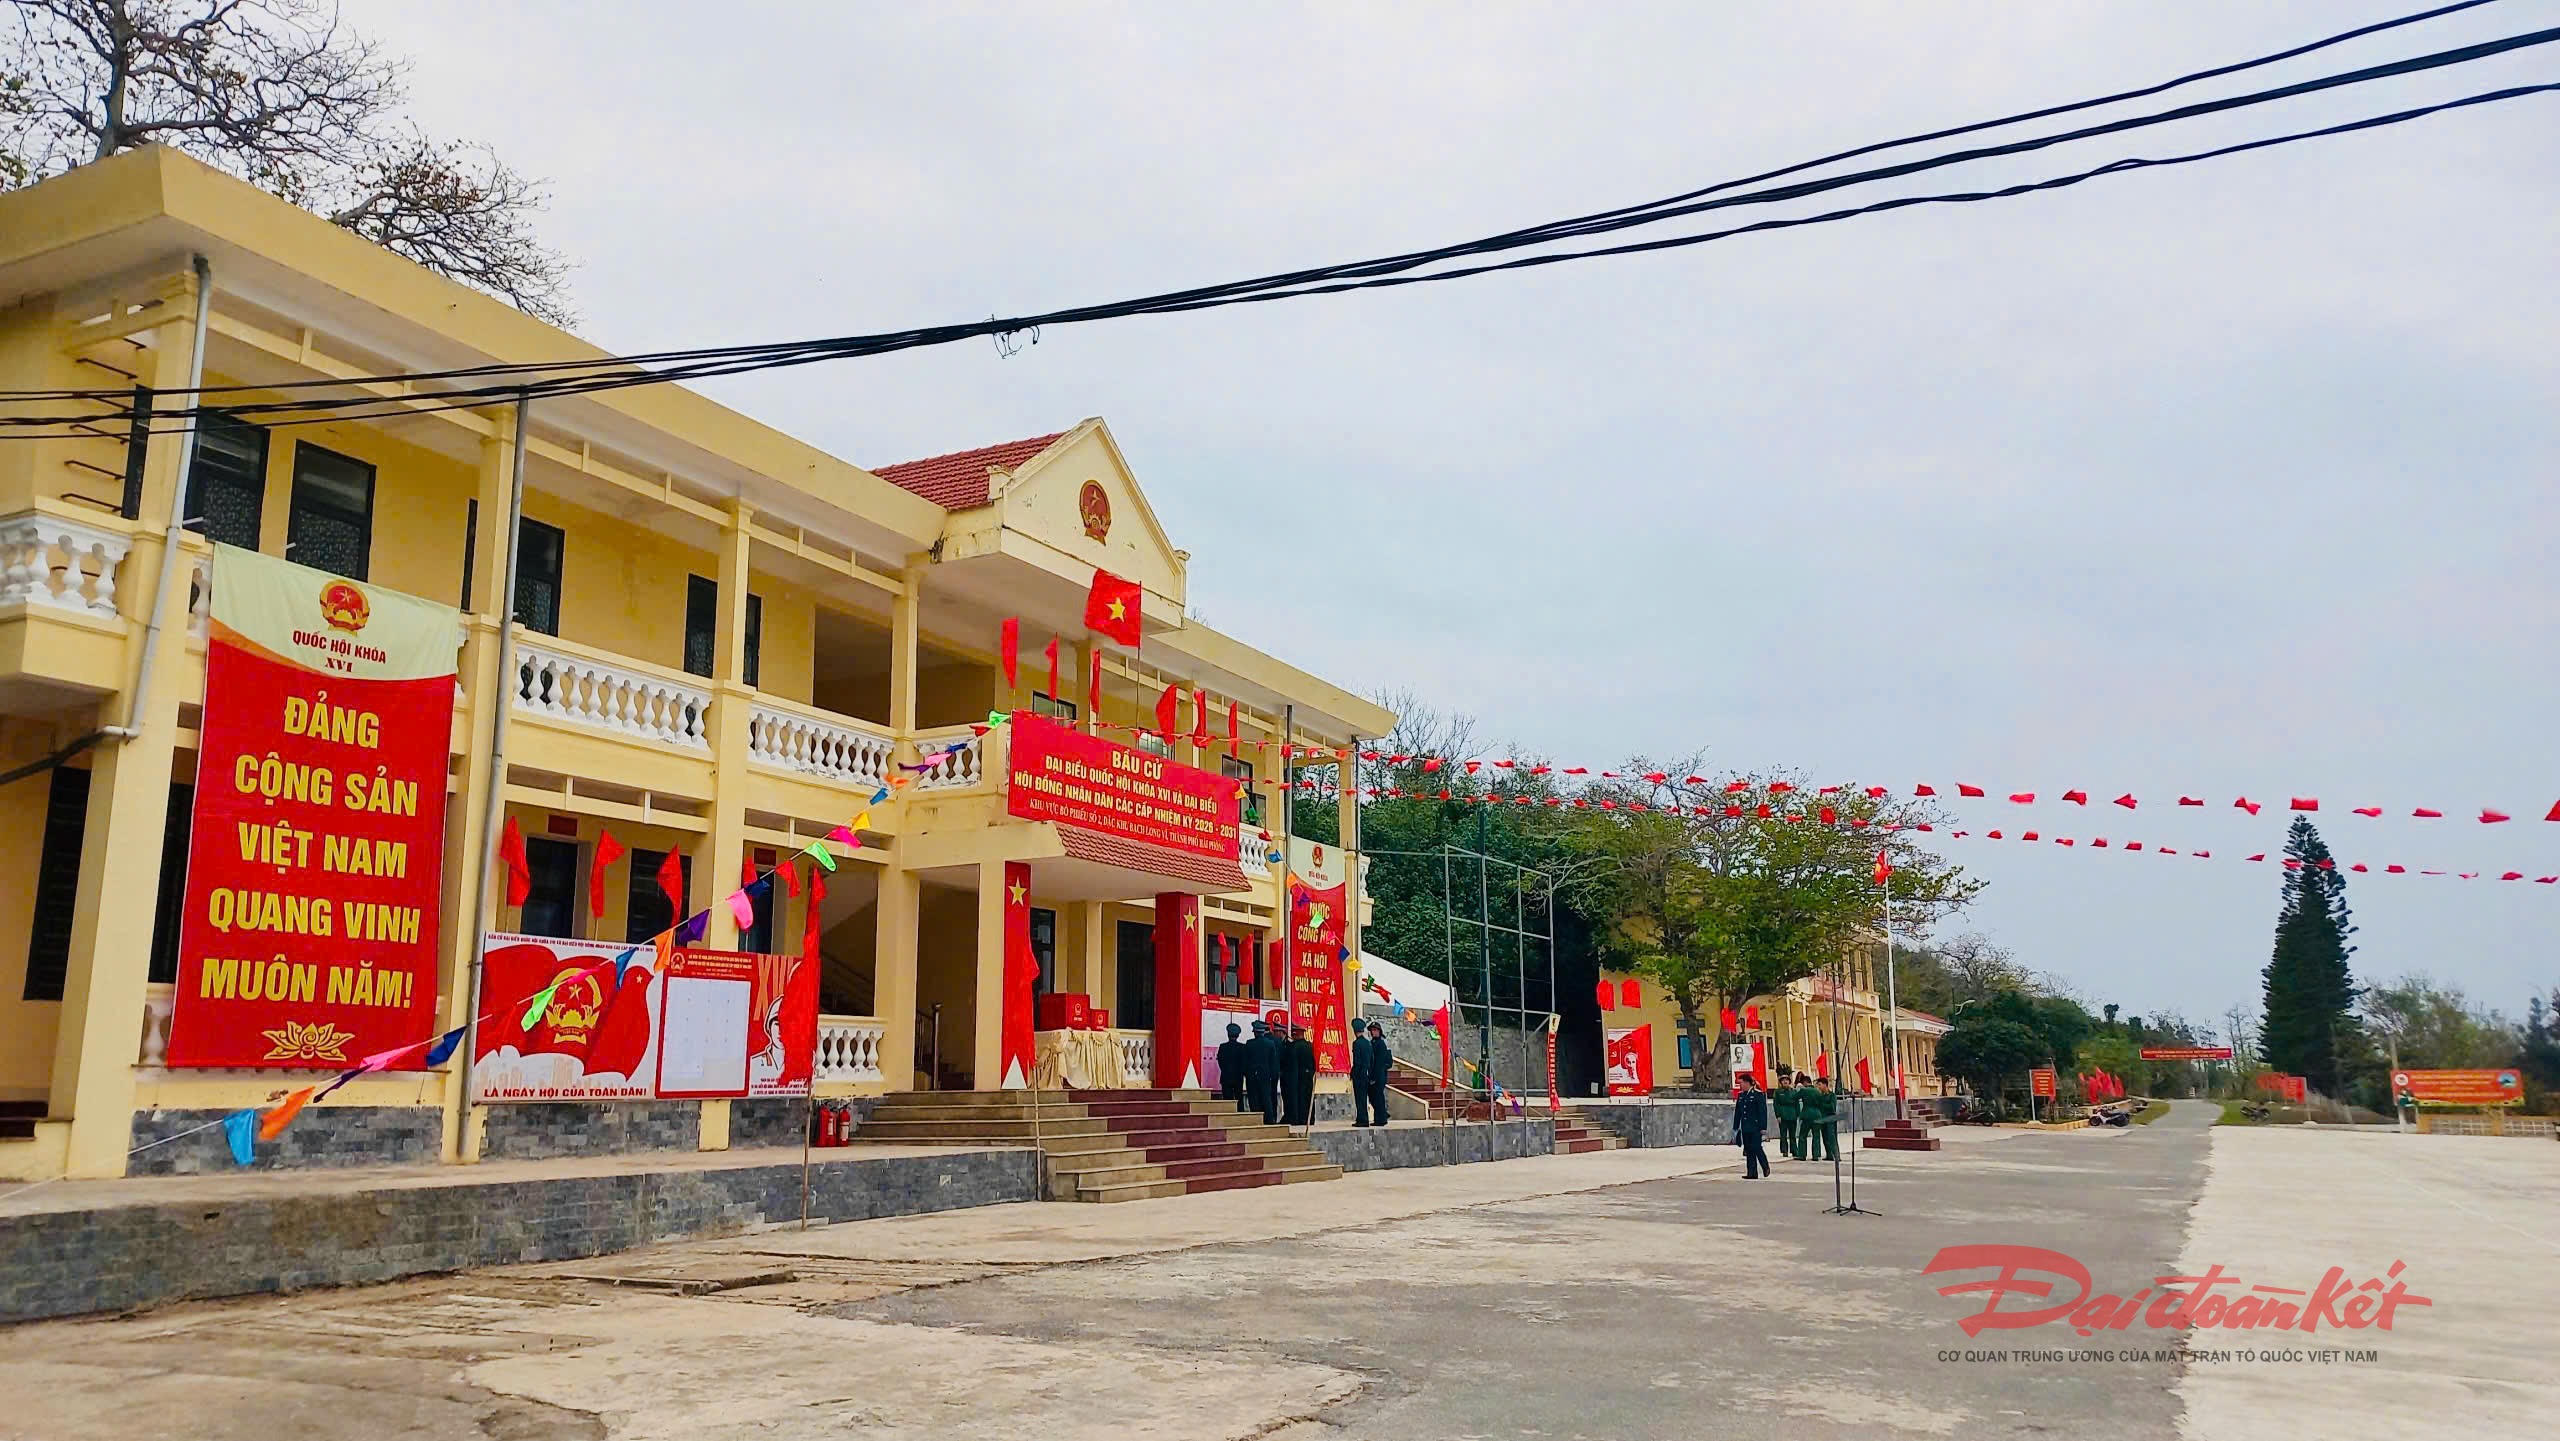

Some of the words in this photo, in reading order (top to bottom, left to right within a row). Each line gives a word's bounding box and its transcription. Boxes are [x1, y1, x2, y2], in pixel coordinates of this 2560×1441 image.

[293, 630, 327, 650] QUỐC
[330, 639, 352, 657] HỘI
[354, 646, 386, 664] KHÓA
[325, 657, 353, 673] XVI
[284, 691, 379, 748] ĐẢNG
[235, 752, 332, 805] CỘNG
[345, 765, 417, 816] SẢN
[1045, 755, 1062, 775] ĐẠI
[1065, 759, 1087, 779] BIỂU
[1089, 768, 1114, 786] QUỐC
[1116, 775, 1131, 793] HỘI
[1133, 780, 1155, 799] KHÓA
[1157, 786, 1171, 803] XVI
[1172, 790, 1183, 805] VÀ
[1184, 795, 1198, 811] ĐẠI
[1200, 797, 1217, 814] BIỂU
[1112, 749, 1140, 773] BẦU
[1144, 757, 1163, 780] CỬ
[1015, 770, 1032, 790] HỘI
[1065, 784, 1091, 804] NHÂN
[1094, 791, 1113, 809] DÂN
[1116, 797, 1133, 814] CÁC
[1136, 801, 1152, 819] CẤP
[1154, 808, 1181, 827] NHIỆM
[1195, 818, 1214, 833] 2026
[1220, 825, 1237, 840] 2031
[238, 820, 313, 874] VIỆT
[323, 834, 407, 878] NAM
[208, 888, 332, 936] QUANG
[343, 902, 421, 944] VINH
[200, 953, 317, 1003] MUÔN
[327, 960, 413, 1009] NĂM!
[1314, 952, 1327, 972] HỘI
